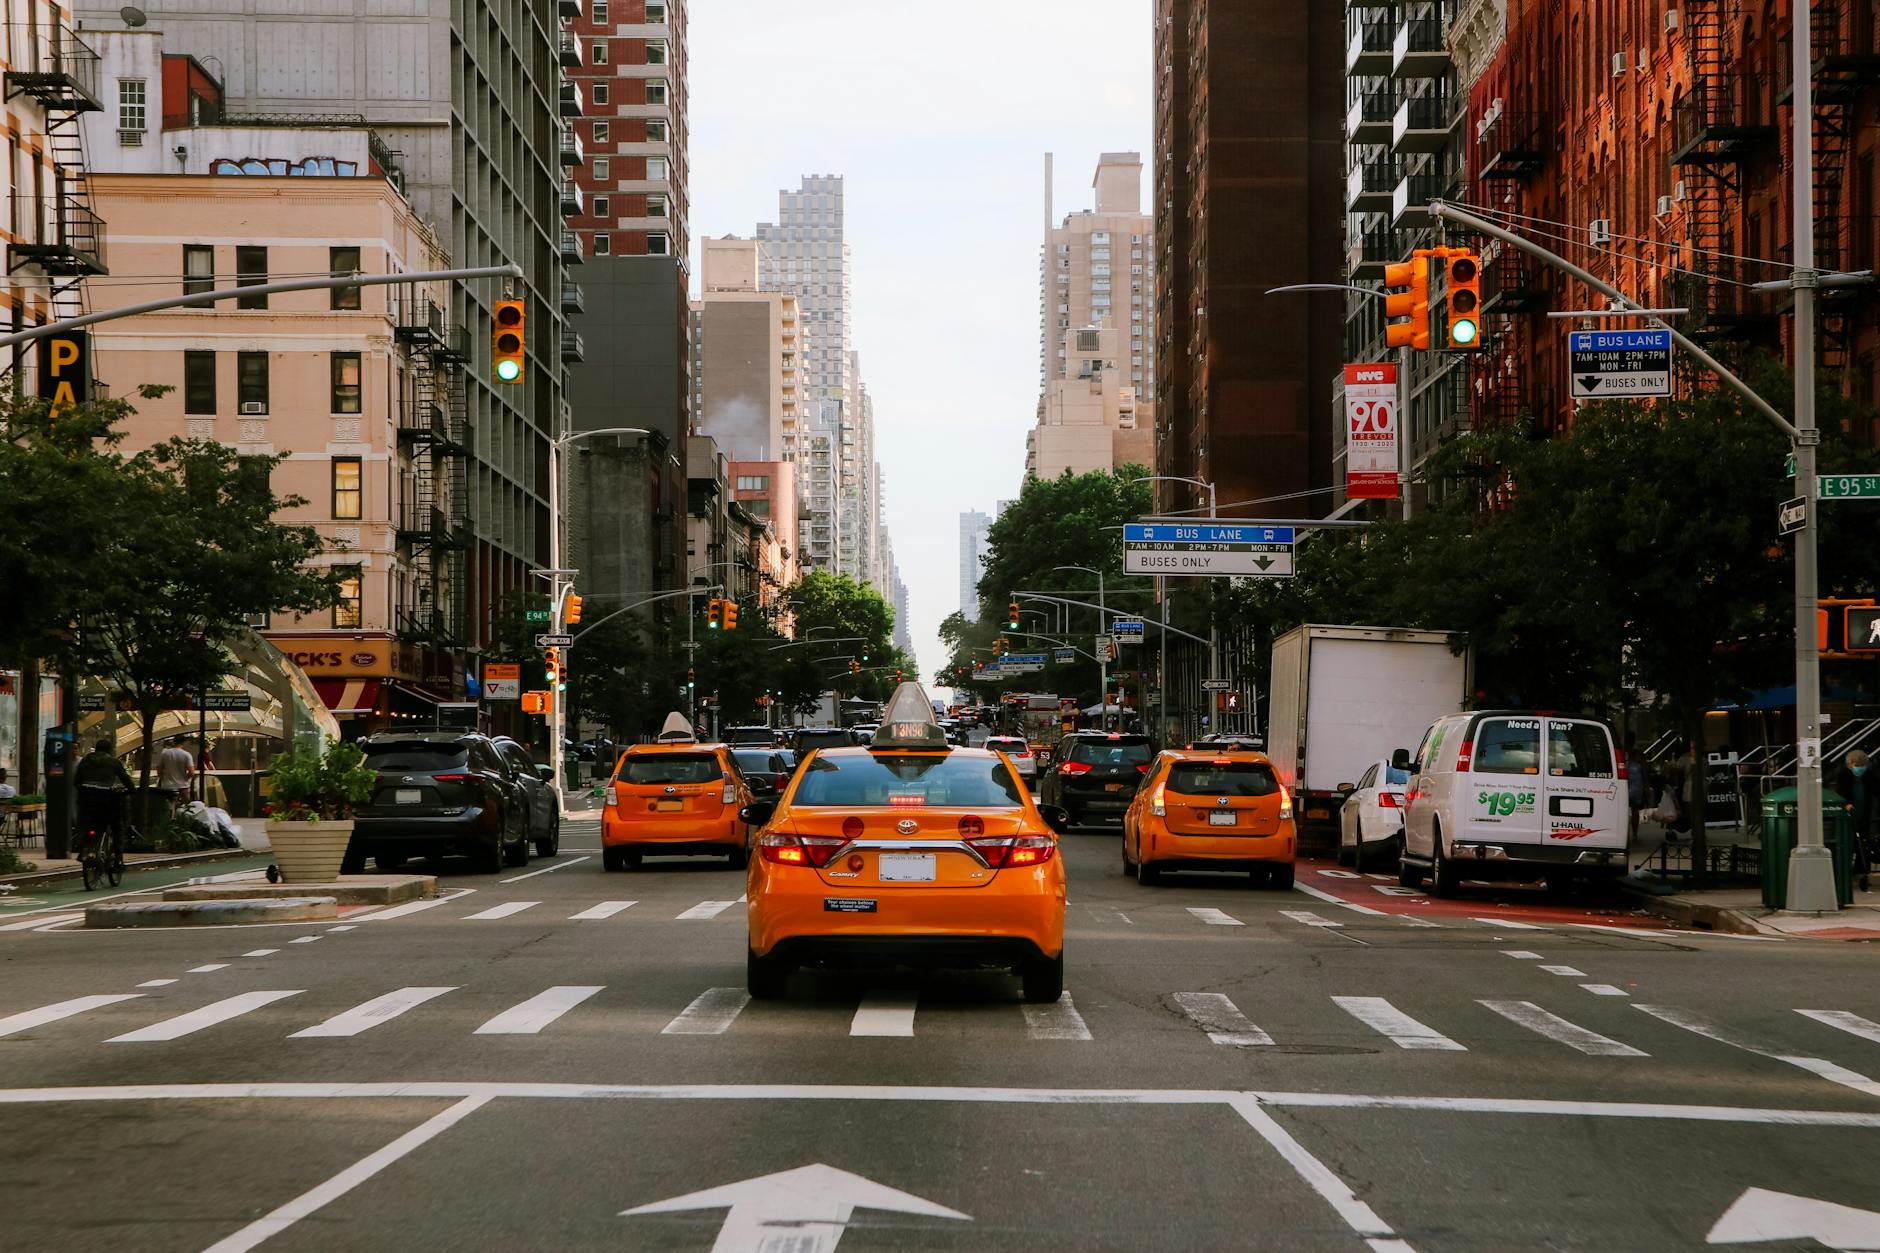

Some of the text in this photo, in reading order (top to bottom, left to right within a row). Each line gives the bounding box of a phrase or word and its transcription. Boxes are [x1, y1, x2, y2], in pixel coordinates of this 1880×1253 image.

[1598, 335, 1662, 347] BUS LANE
[1625, 351, 1666, 360] 2PM-7PM
[1600, 361, 1618, 371] MON
[1627, 361, 1642, 370] FRI
[1356, 371, 1384, 381] NYC
[1605, 377, 1665, 388] BUSES ONLY
[1351, 400, 1394, 433] 90
[1825, 478, 1876, 496] E 95 St
[1176, 529, 1242, 540] BUS LANE
[1141, 557, 1211, 568] BUSES ONLY
[533, 612, 542, 620] 94
[1507, 720, 1532, 729] Need
[1550, 722, 1574, 731] Van?
[55, 742, 64, 753] P
